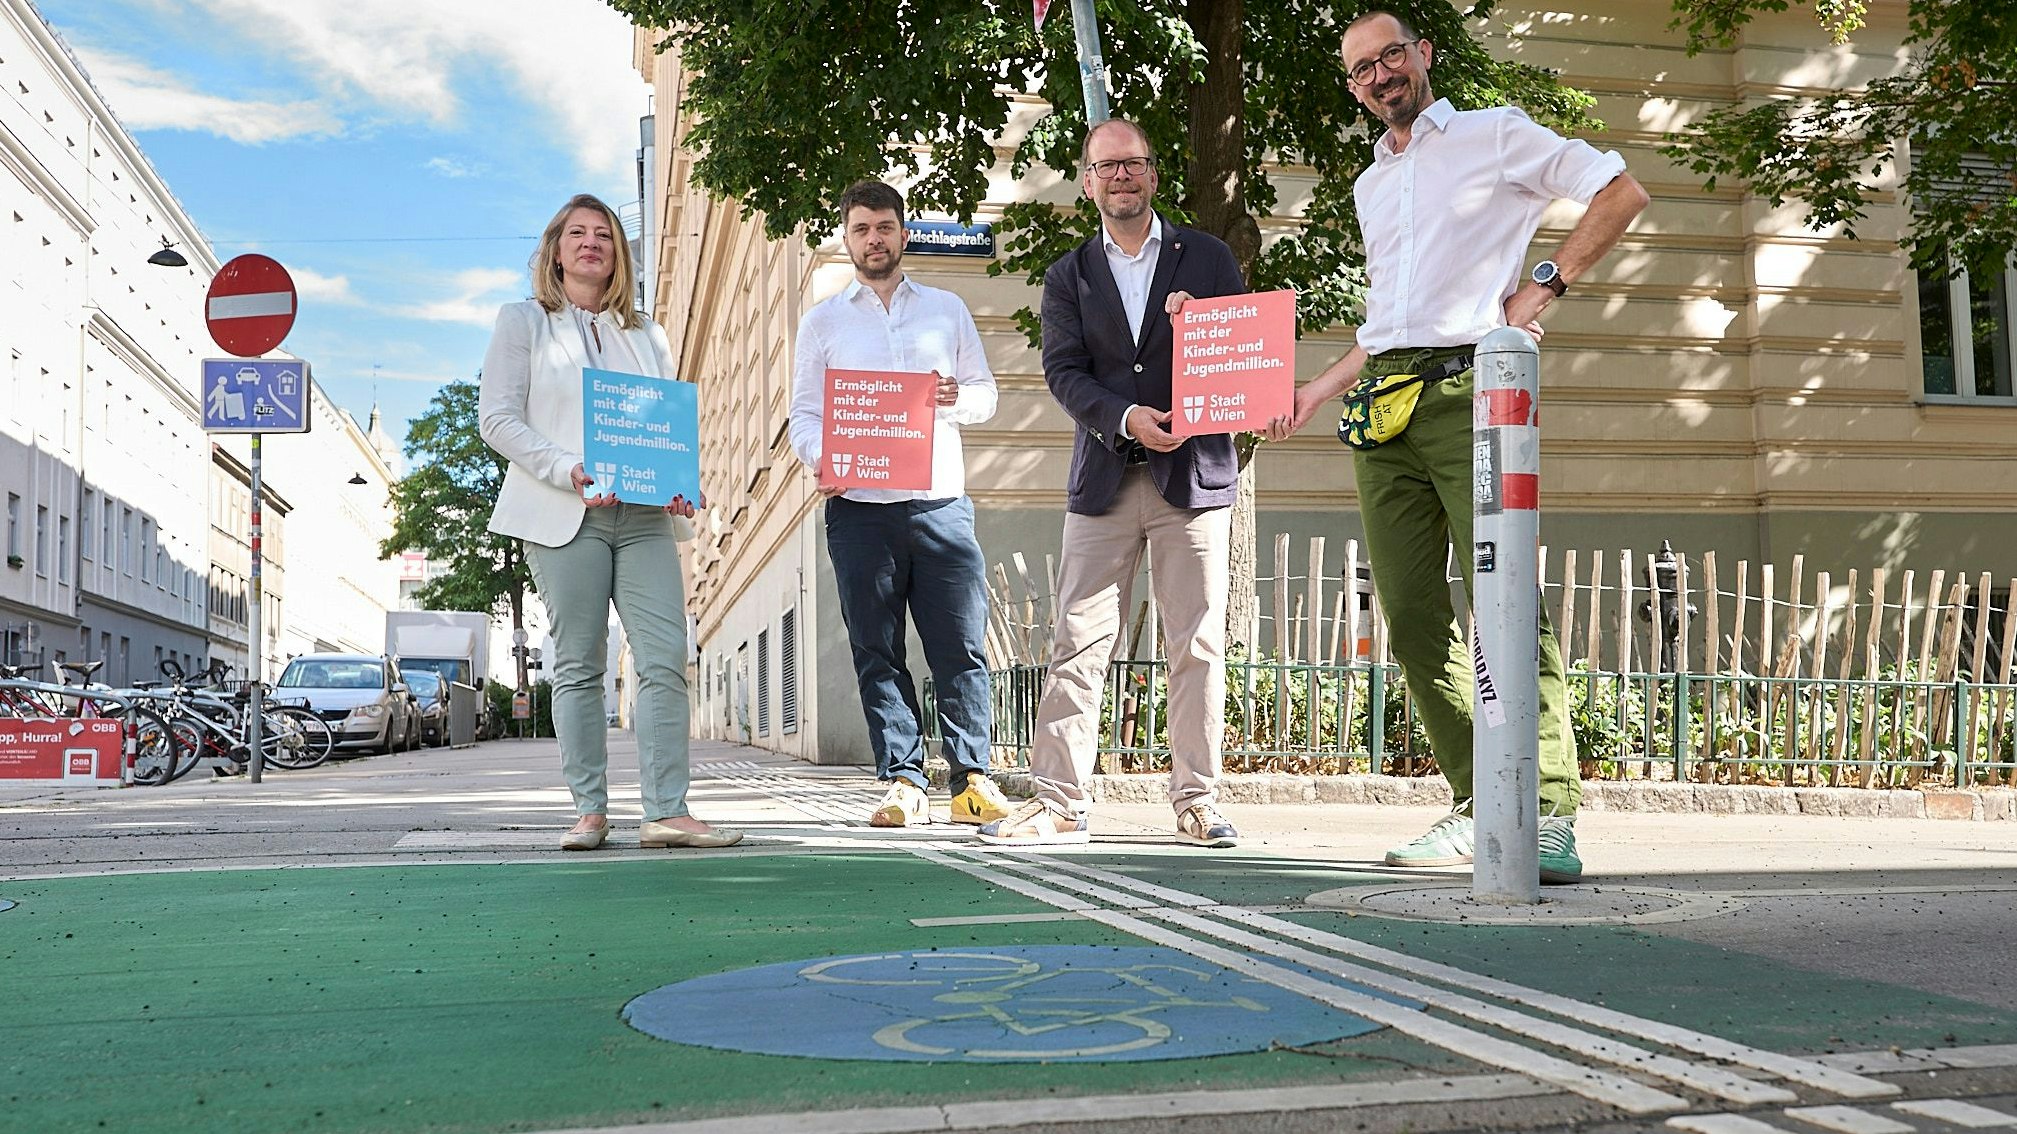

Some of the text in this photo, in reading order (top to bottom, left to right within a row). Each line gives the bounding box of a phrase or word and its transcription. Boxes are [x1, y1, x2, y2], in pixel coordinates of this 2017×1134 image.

[908, 228, 991, 248] ldschlagstraße
[1184, 305, 1258, 325] Ermöglicht
[1183, 325, 1232, 341] mit der
[1183, 338, 1264, 358] Kinder- und
[1183, 356, 1284, 377] Jugendmillion.
[593, 380, 664, 401] Ermöglicht
[834, 379, 903, 395] Ermöglicht
[593, 399, 641, 414] mit der
[833, 394, 879, 407] mit der
[1210, 393, 1246, 408] Stadt
[593, 413, 671, 433] Kinder- und
[833, 409, 908, 423] Kinder- und
[1209, 408, 1246, 422] Wien
[1374, 404, 1386, 435] FRISH
[832, 425, 926, 440] Jugendmillion.
[593, 430, 690, 453] Jugendmillion.
[856, 454, 890, 468] Stadt
[621, 465, 656, 481] Stadt
[856, 467, 890, 479] Wien
[622, 479, 657, 494] Wien
[22, 732, 62, 742] Hurra!
